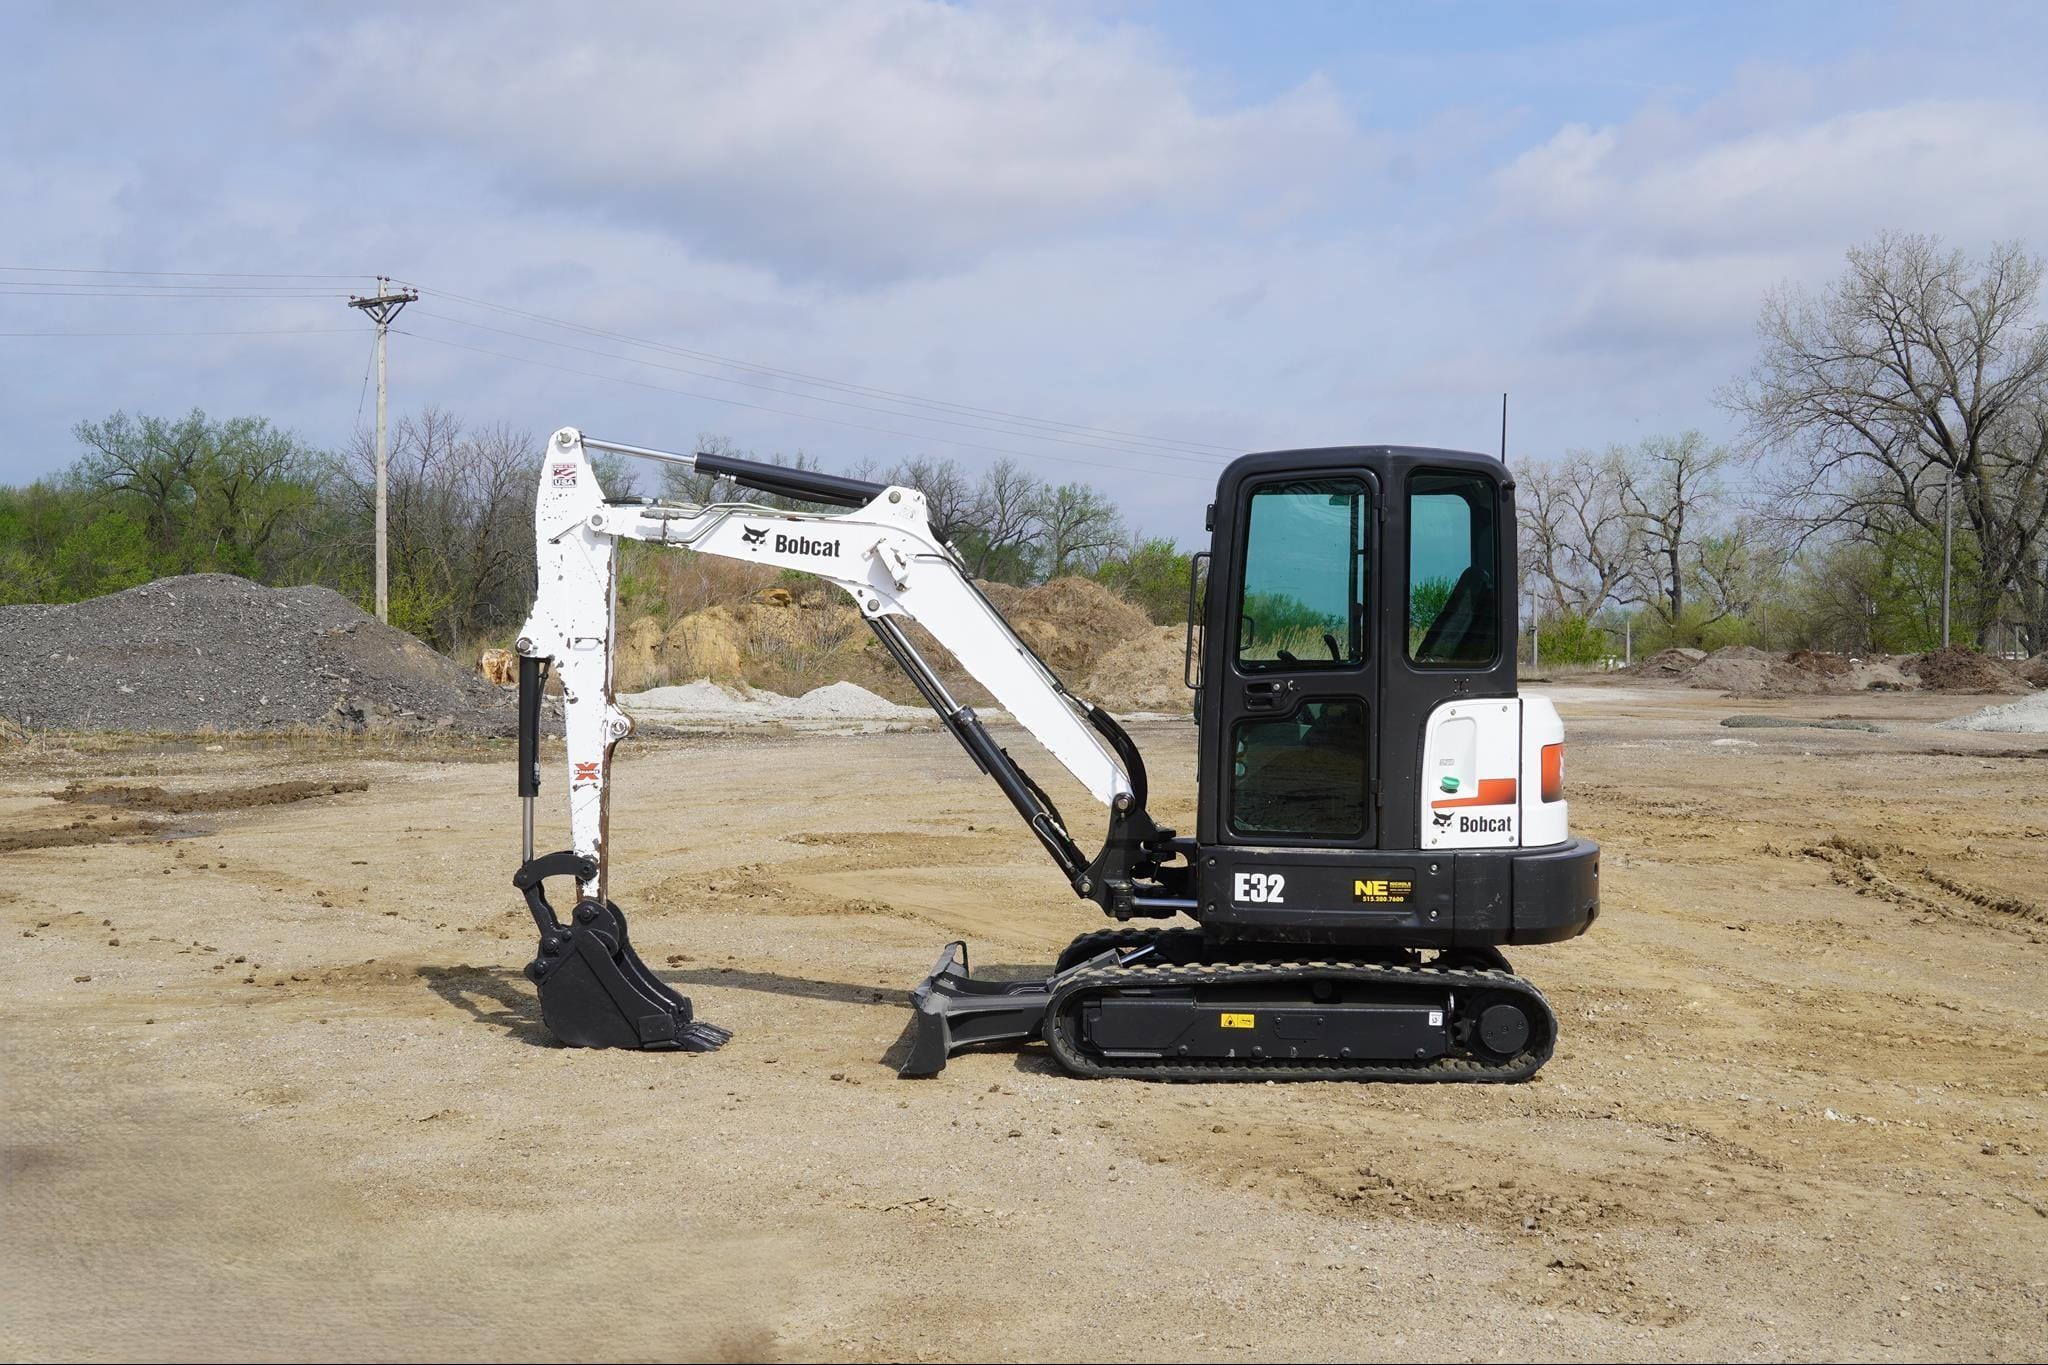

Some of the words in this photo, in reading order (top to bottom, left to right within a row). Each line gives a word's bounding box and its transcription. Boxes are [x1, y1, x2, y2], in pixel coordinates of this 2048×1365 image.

[776, 534, 840, 557] Bobcat
[1460, 816, 1511, 832] Bobcat
[1234, 873, 1284, 903] E32
[1355, 880, 1388, 895] NE
